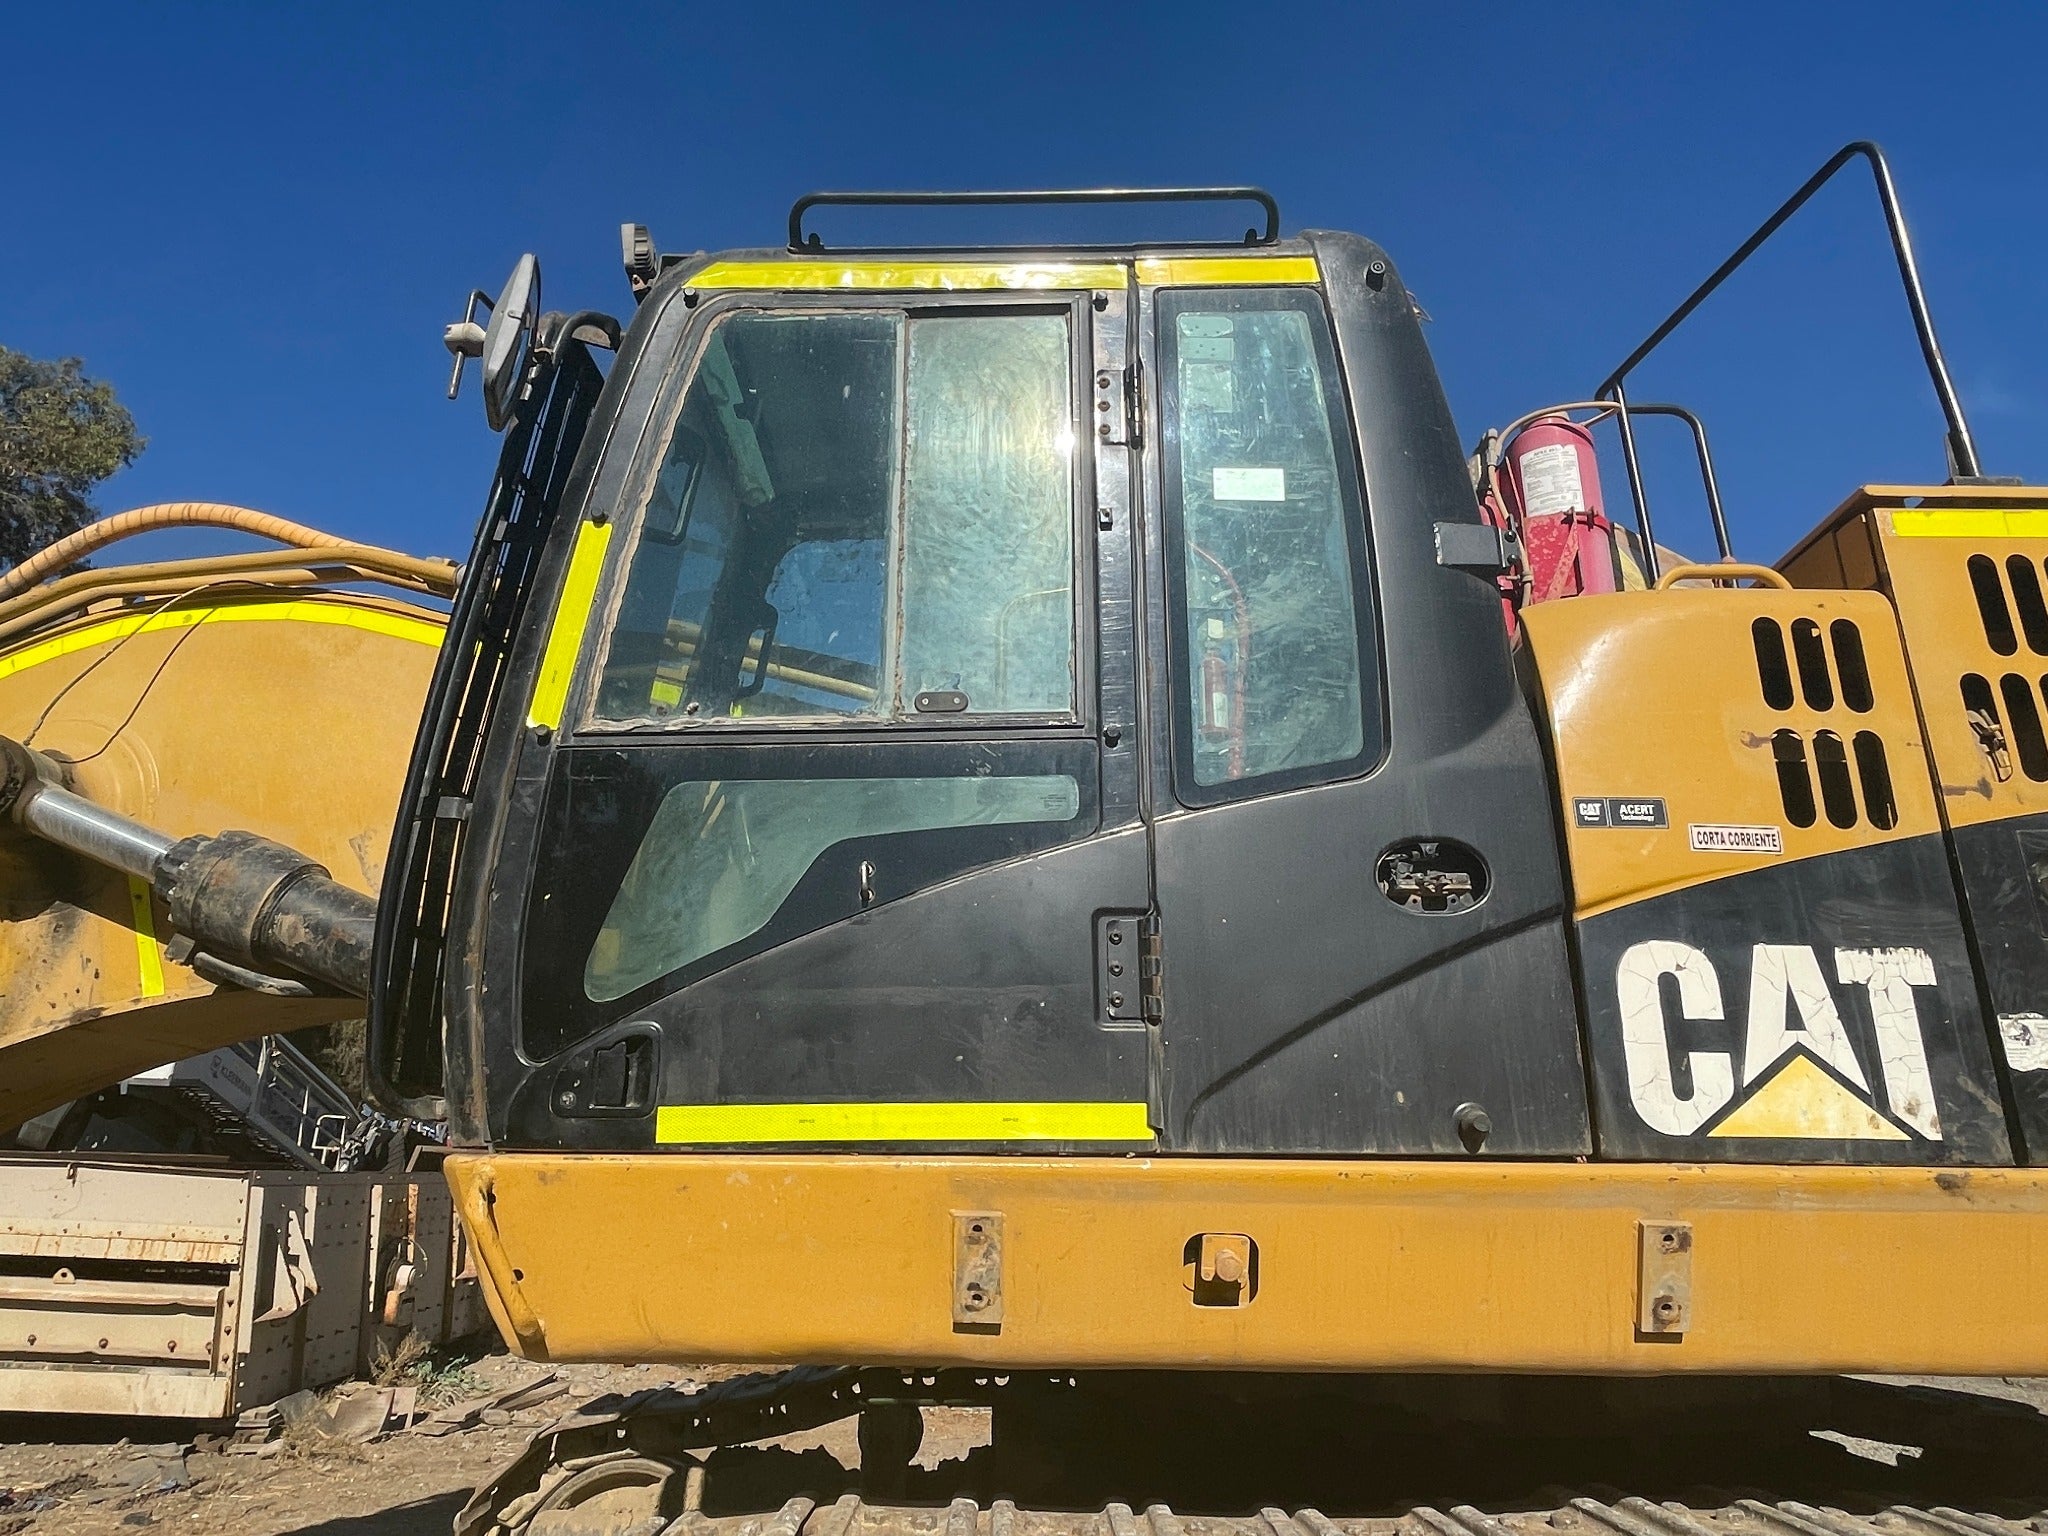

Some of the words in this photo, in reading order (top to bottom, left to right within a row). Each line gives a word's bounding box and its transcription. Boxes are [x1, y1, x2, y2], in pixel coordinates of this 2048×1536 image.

[1579, 803, 1602, 816] CAT
[1620, 804, 1655, 815] ACERT
[1620, 814, 1655, 822] Technology
[1697, 831, 1726, 846] CORTA
[1727, 832, 1778, 848] CORRIENTE
[1617, 940, 1943, 1141] CAT
